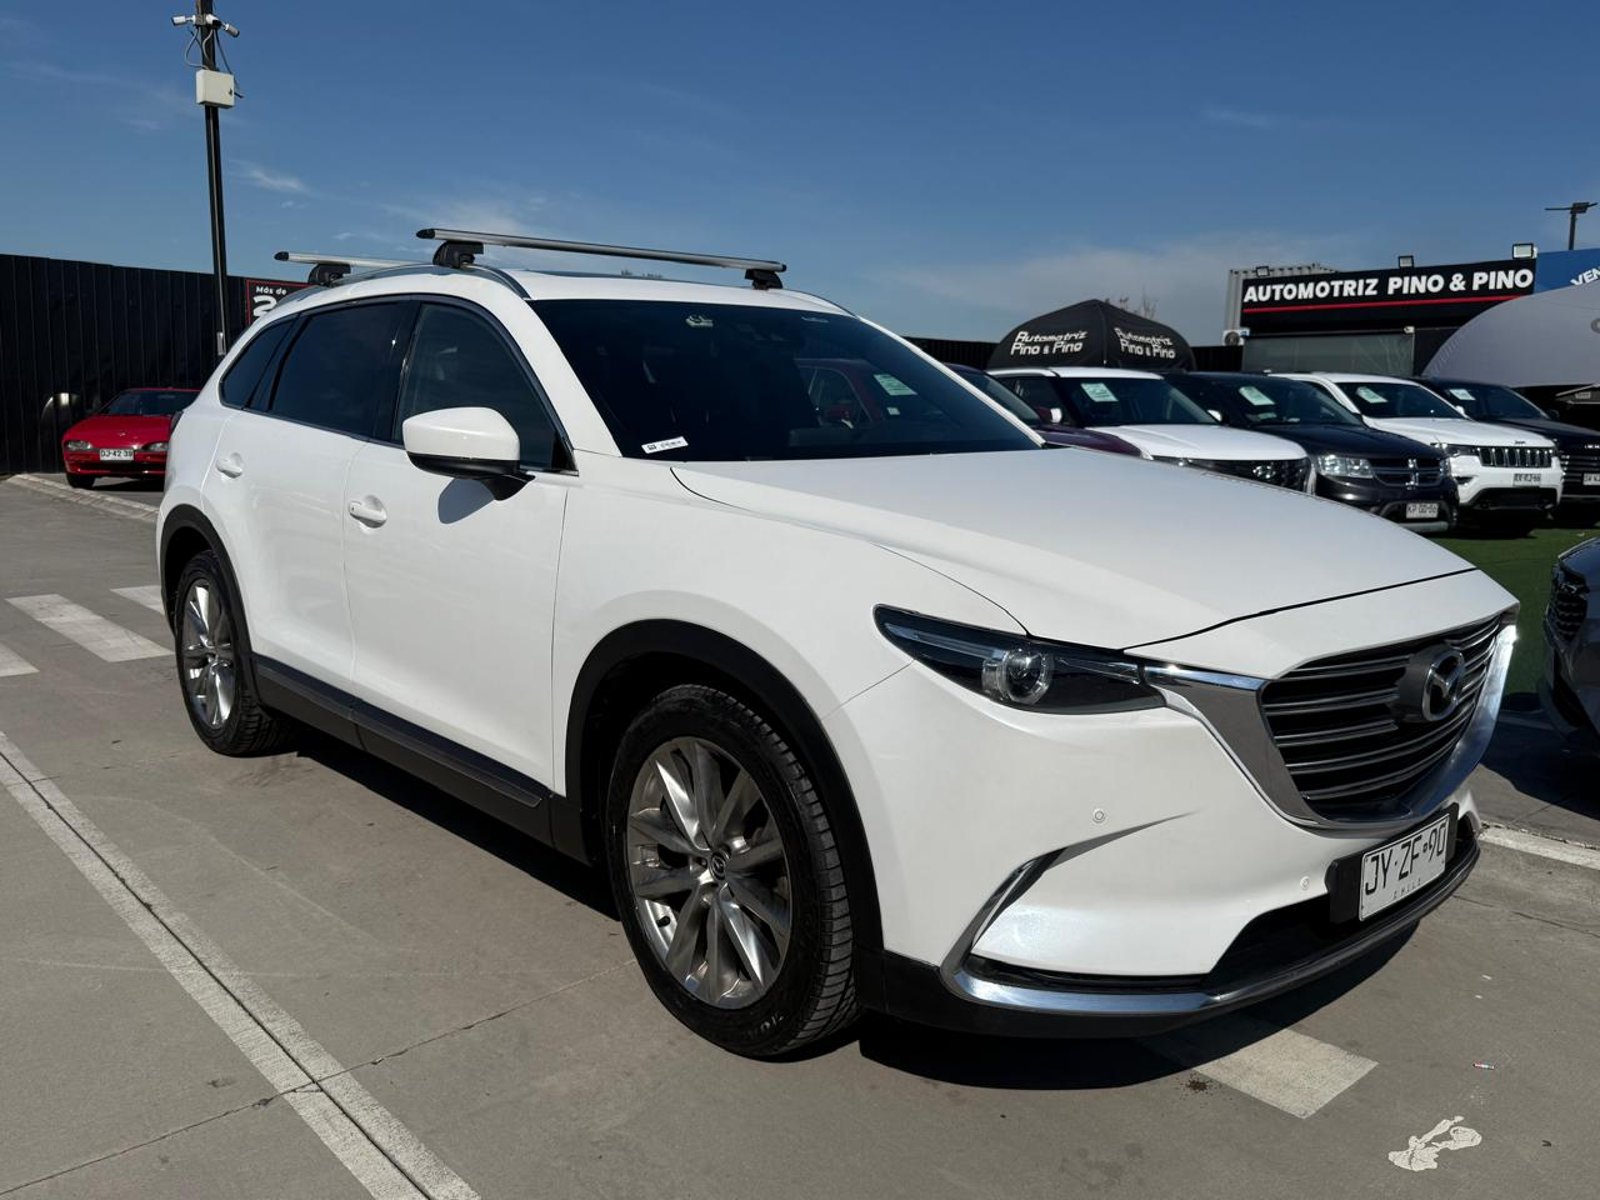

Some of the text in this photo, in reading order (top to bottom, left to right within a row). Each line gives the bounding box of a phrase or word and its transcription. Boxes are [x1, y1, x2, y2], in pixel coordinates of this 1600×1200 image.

[275, 286, 287, 295] de
[1243, 268, 1534, 302] AUTOMOTRIZ PINO & PINO
[1010, 341, 1040, 355] Pino
[1052, 340, 1083, 354] Pino
[1120, 339, 1143, 355] Pino
[1152, 344, 1176, 359] Pino
